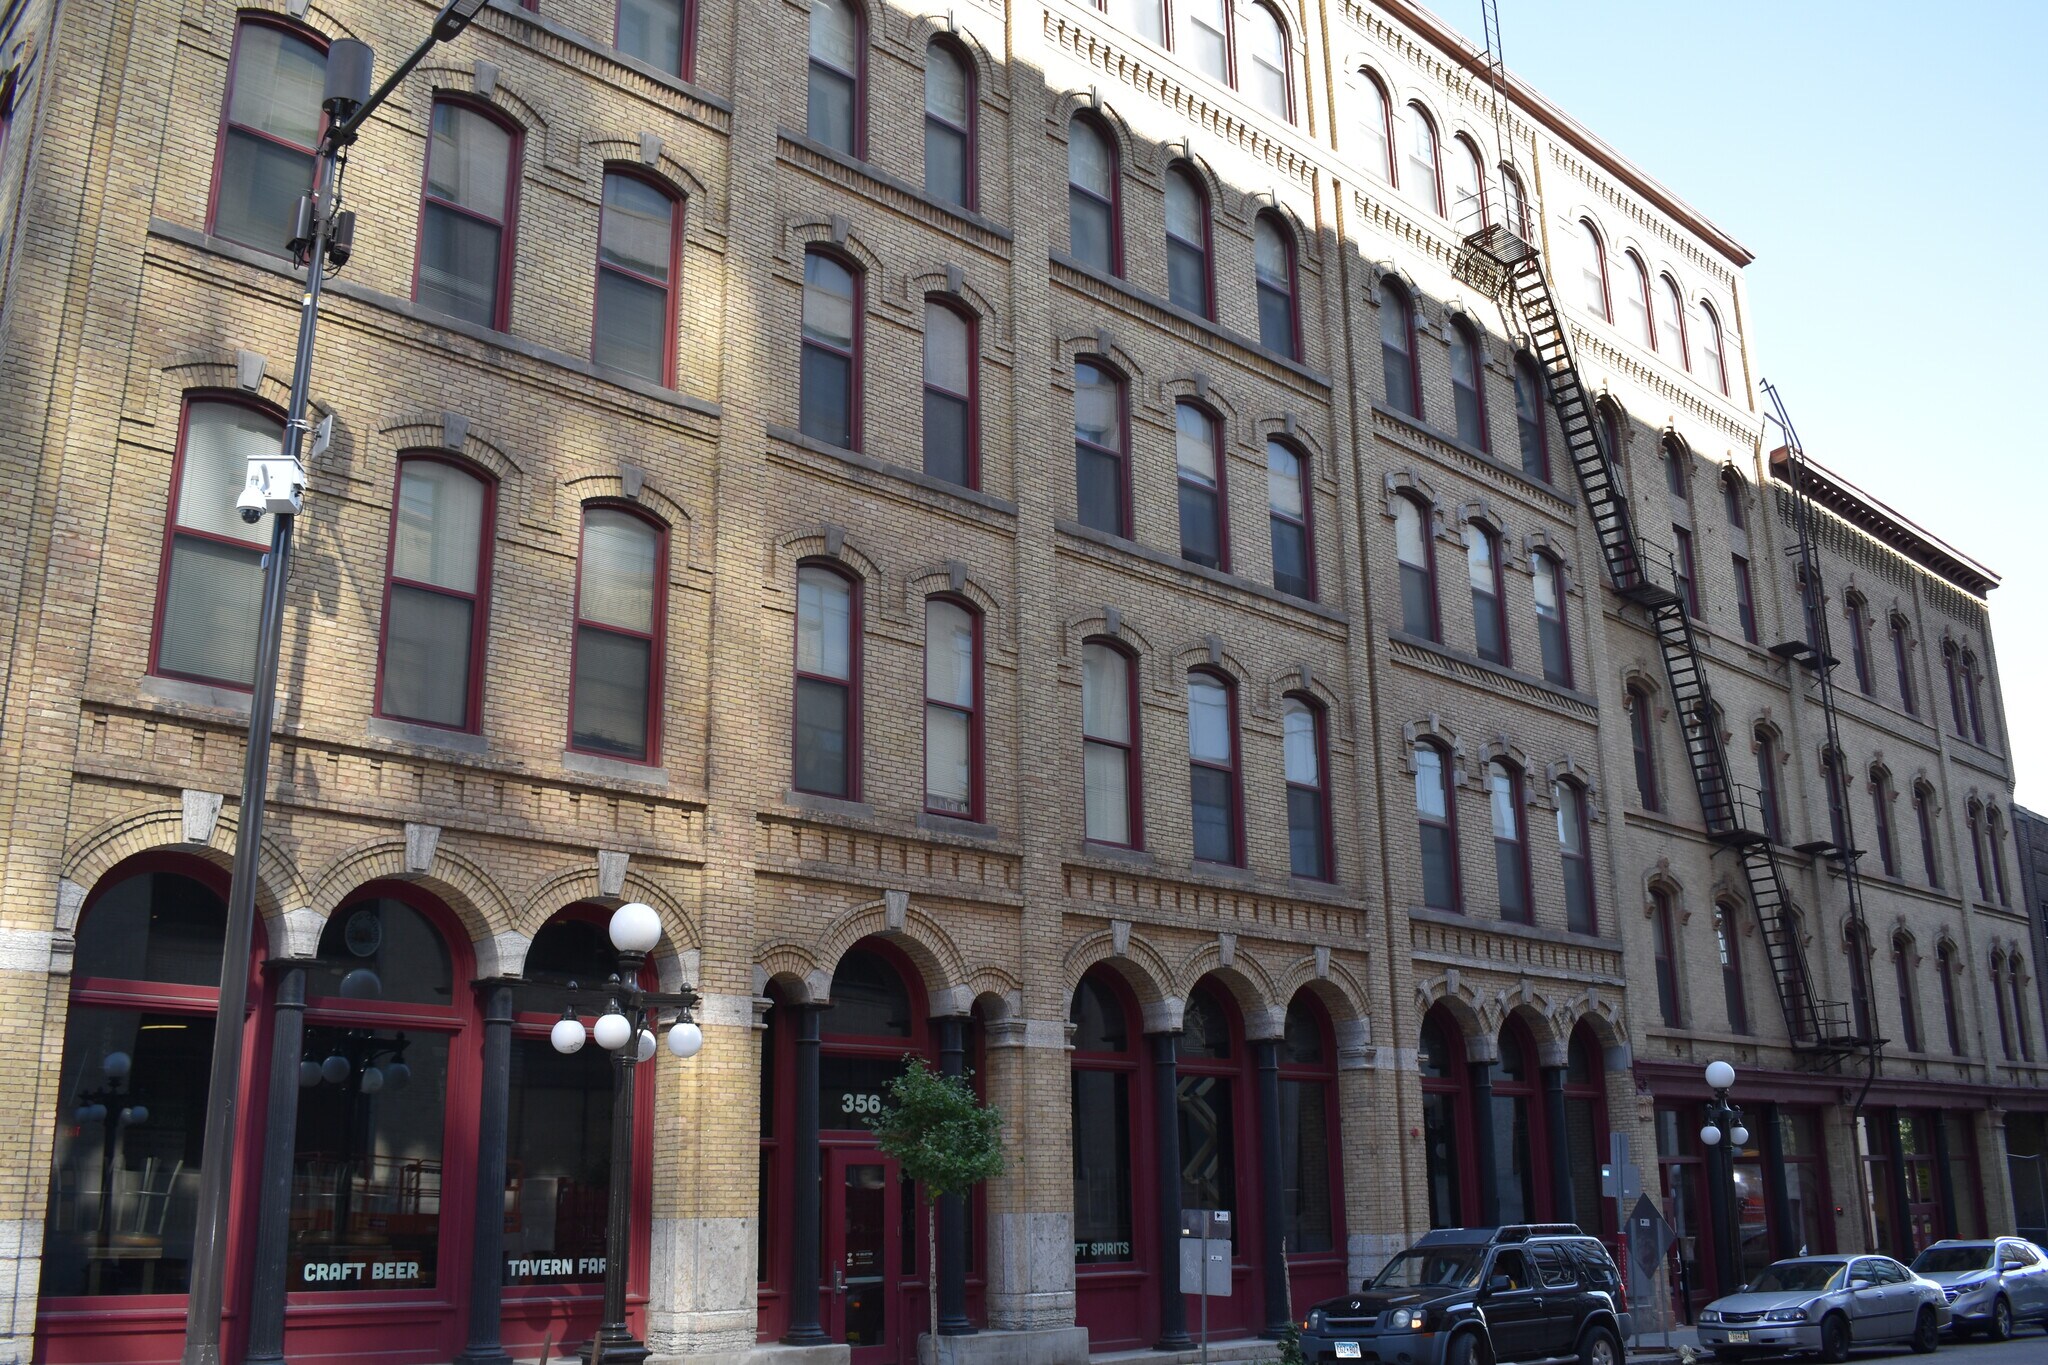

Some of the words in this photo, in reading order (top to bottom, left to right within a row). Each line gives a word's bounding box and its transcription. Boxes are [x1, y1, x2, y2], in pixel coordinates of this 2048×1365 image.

[841, 1093, 881, 1114] 356
[1074, 1243, 1088, 1257] FT
[1091, 1241, 1130, 1256] SPIRITS
[303, 1262, 367, 1281] CRAFT
[371, 1261, 419, 1280] BEER
[507, 1259, 573, 1277] TAVERN
[578, 1257, 607, 1275] FAR
